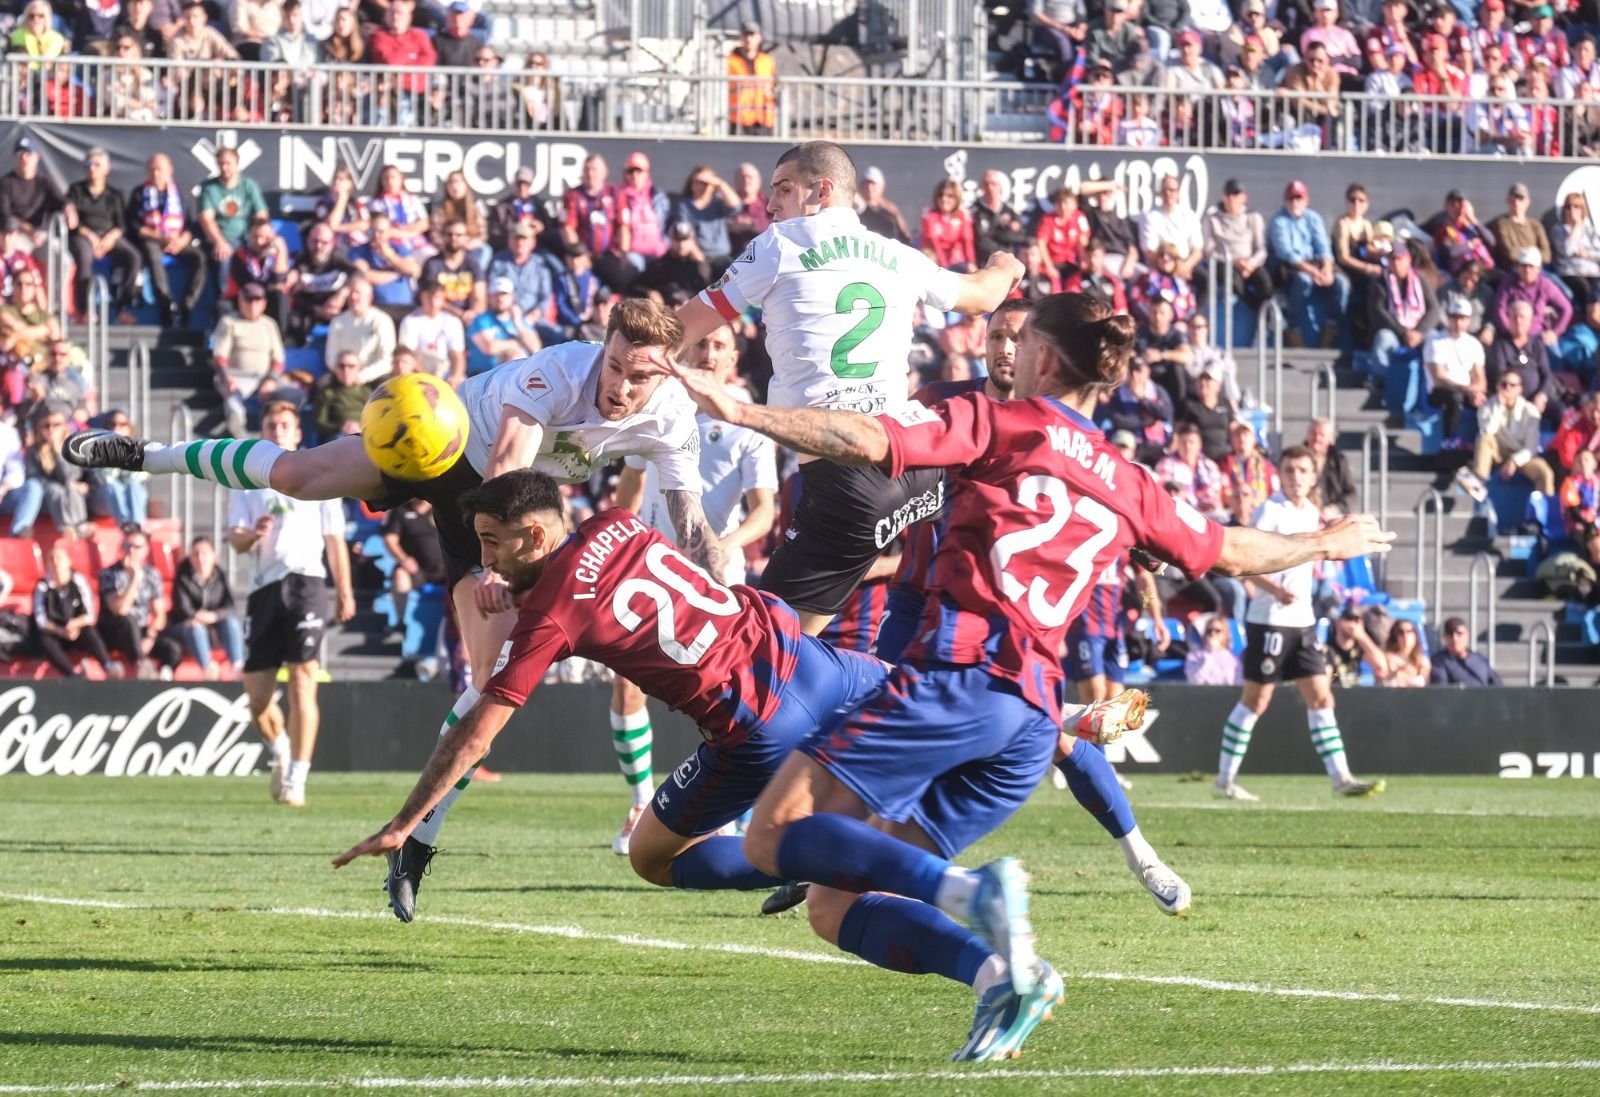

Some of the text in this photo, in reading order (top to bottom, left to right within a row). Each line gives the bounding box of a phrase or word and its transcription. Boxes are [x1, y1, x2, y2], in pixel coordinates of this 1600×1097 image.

[279, 135, 589, 196] INVERCUR
[798, 236, 898, 273] MANTILLA
[830, 281, 887, 379] 2
[990, 474, 1118, 628] 23
[612, 542, 742, 665] 20
[1263, 631, 1283, 657] 10
[0, 686, 282, 777] Coca-Cola
